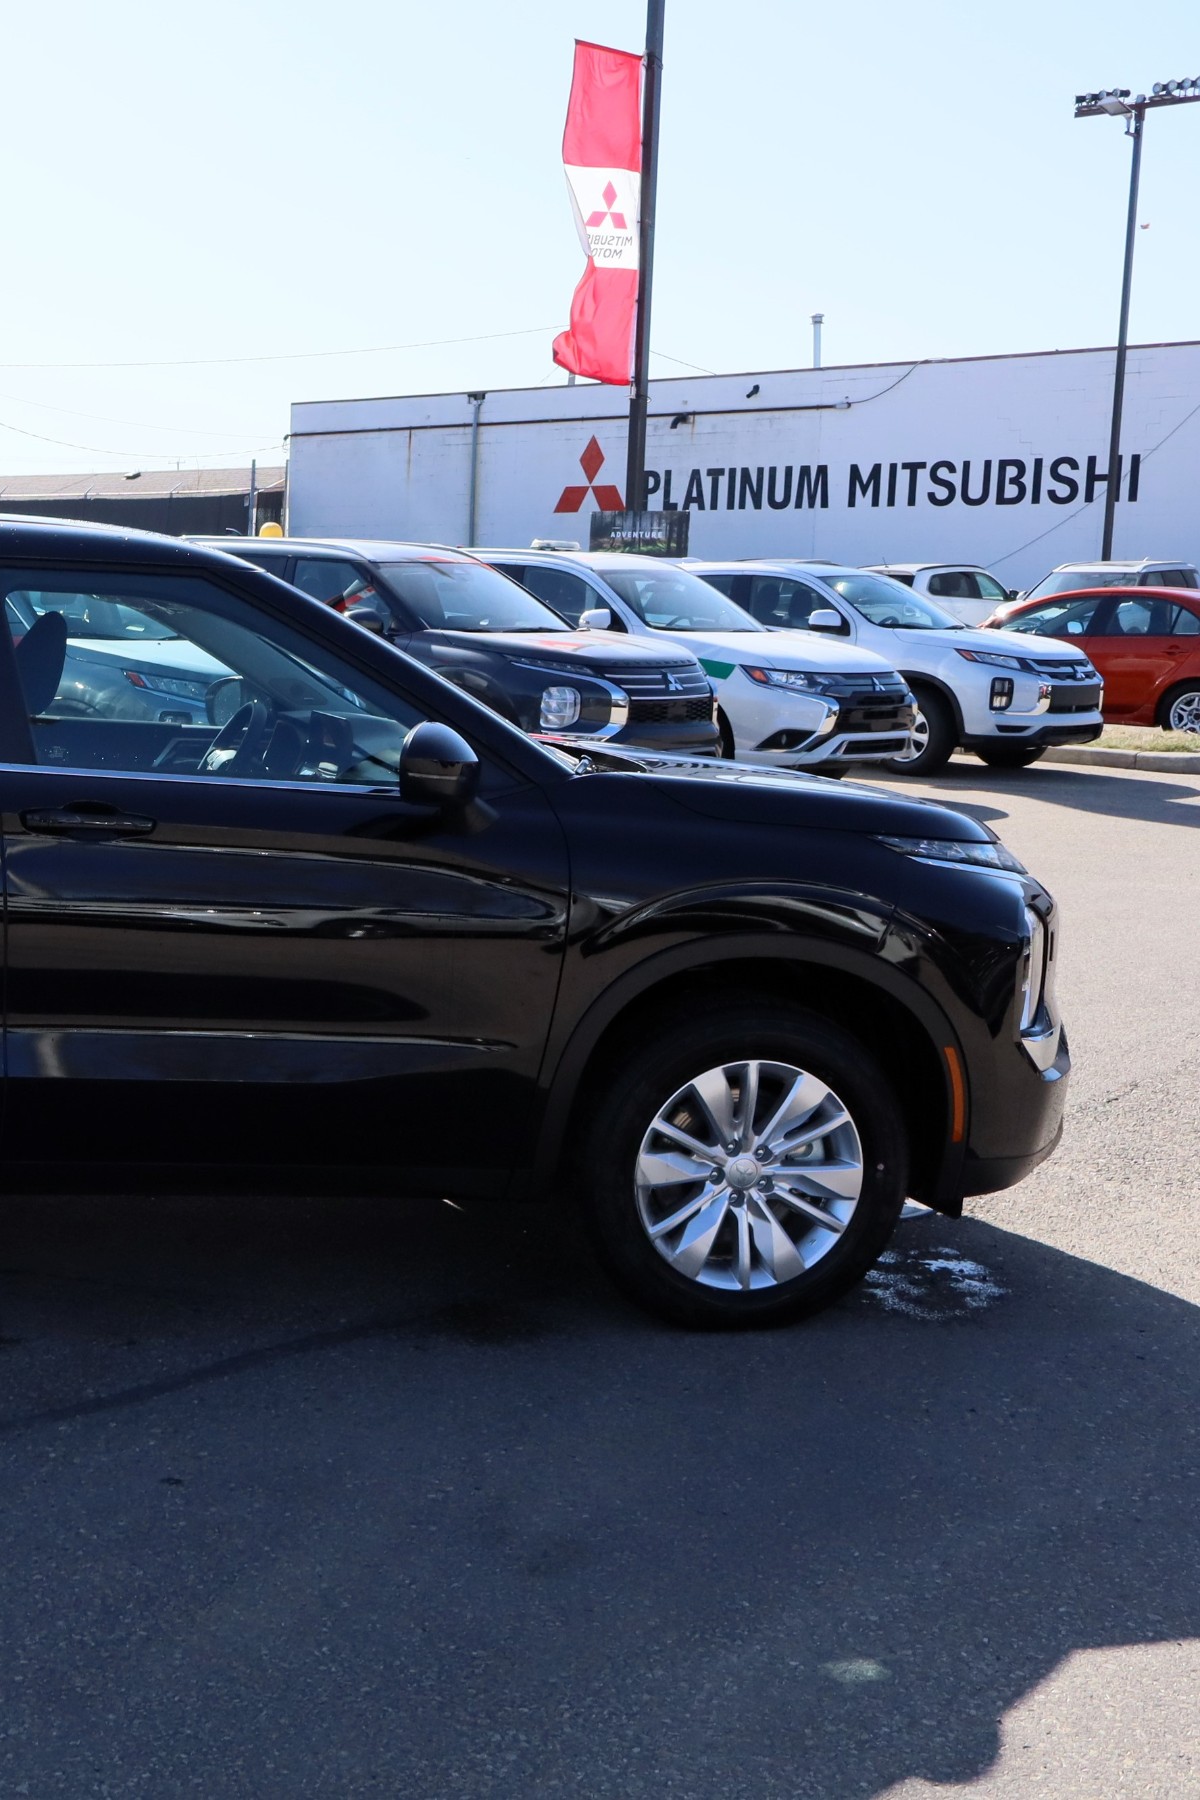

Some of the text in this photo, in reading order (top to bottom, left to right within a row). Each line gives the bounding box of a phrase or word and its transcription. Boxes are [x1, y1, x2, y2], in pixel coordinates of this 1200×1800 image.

[642, 454, 1141, 511] PLATINUM MITSUBISHI
[610, 531, 664, 539] ADVENTURE
